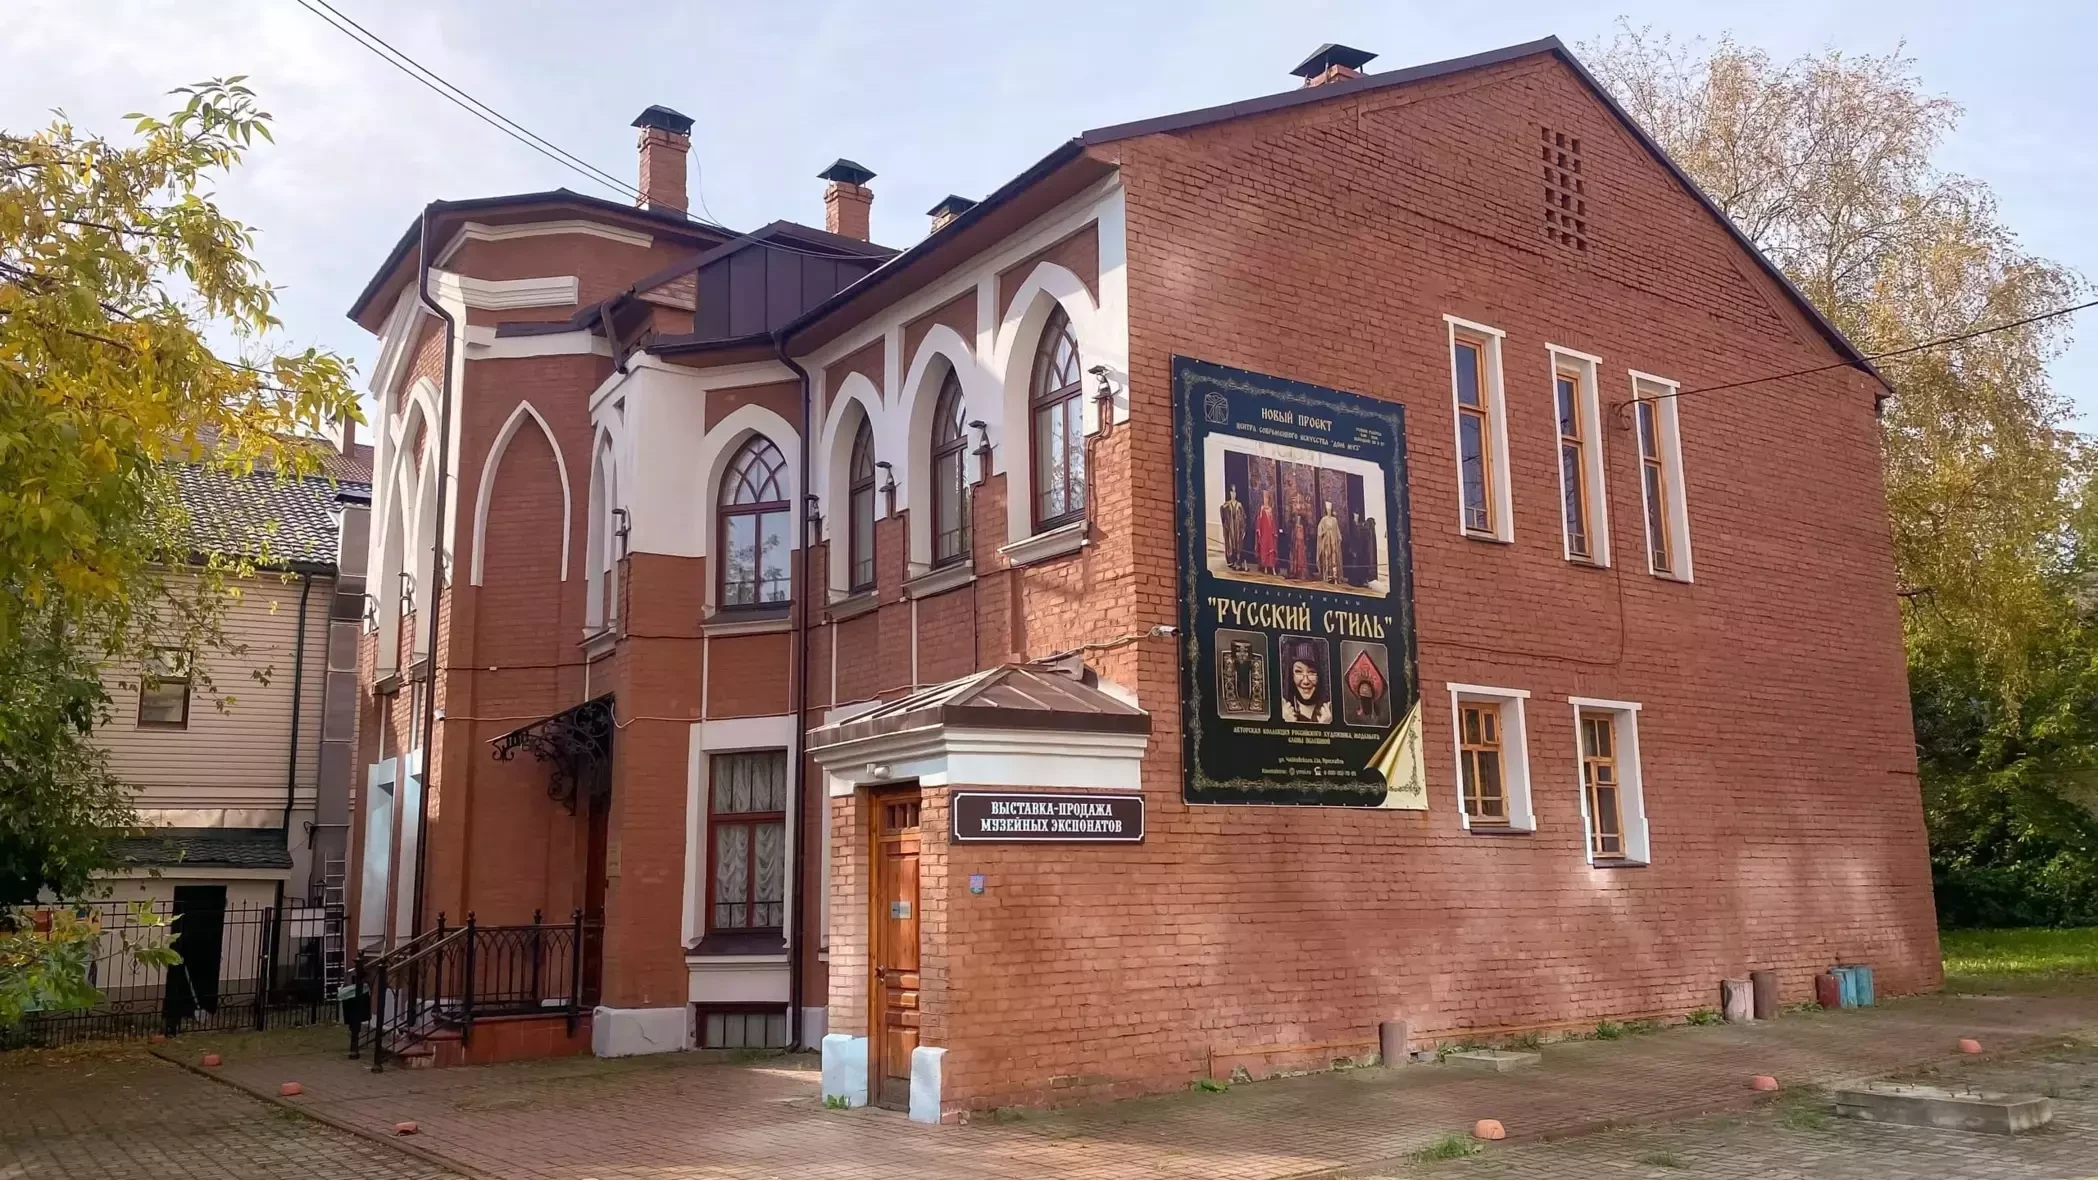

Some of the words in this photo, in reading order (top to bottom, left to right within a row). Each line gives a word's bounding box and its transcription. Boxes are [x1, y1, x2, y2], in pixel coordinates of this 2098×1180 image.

[1261, 407, 1294, 424] НОВЫЙ
[1298, 416, 1333, 432] ПРОЕКТ
[1207, 596, 1311, 632] "РУССКИЙ
[1323, 610, 1393, 639] СТИЛЬ"
[991, 801, 1113, 818] ВЫСТАВКА-ПРОДАЖА
[980, 817, 1049, 832] МУЗЕЙНЫХ
[1051, 819, 1123, 833] ЭКСПОНАТОВ
